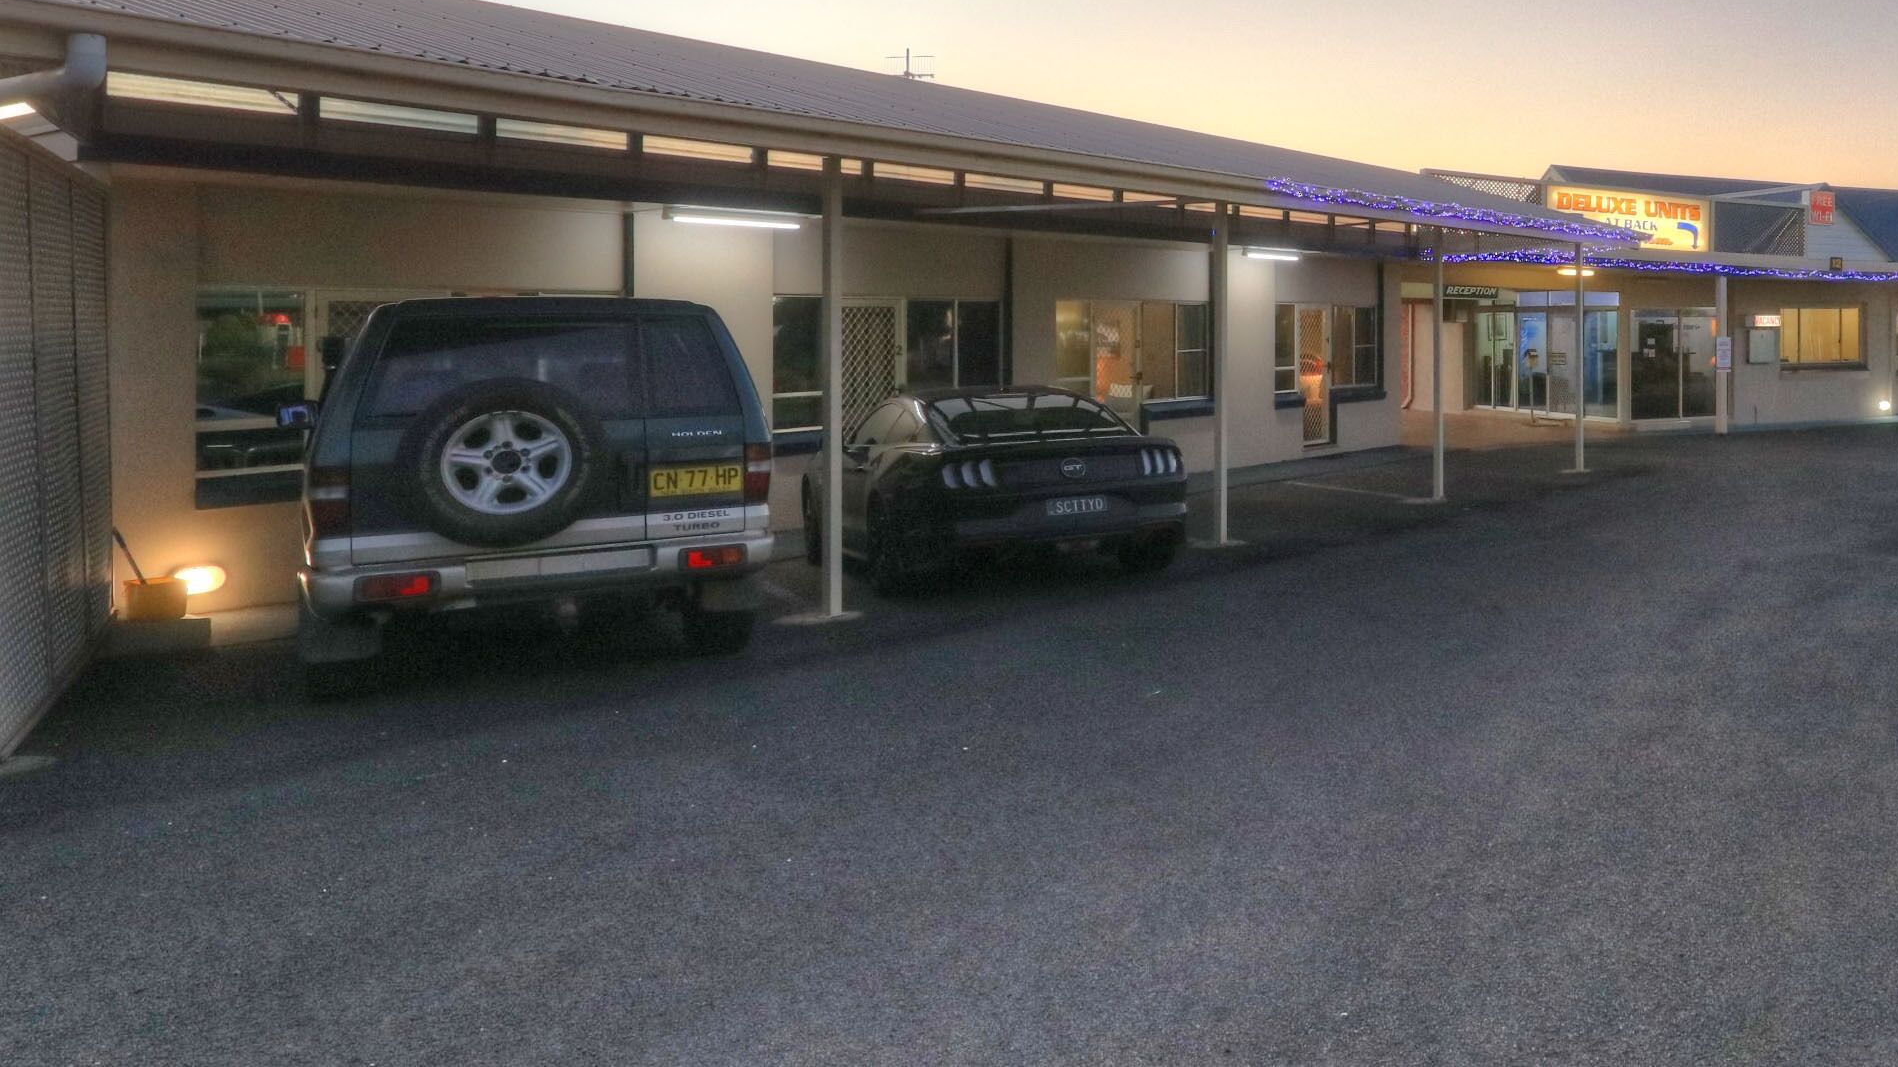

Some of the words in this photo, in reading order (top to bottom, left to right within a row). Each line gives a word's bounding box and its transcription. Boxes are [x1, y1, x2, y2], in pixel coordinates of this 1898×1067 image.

[1557, 192, 1637, 216] DELUXE
[1645, 200, 1701, 221] UNITS
[1812, 194, 1832, 207] FREE
[1605, 217, 1620, 227] AT
[1625, 219, 1658, 231] BACK
[1446, 286, 1497, 295] RECEPTION
[663, 513, 683, 522] 3.0
[687, 509, 731, 520] DIESEL
[673, 521, 721, 532] TURBO
